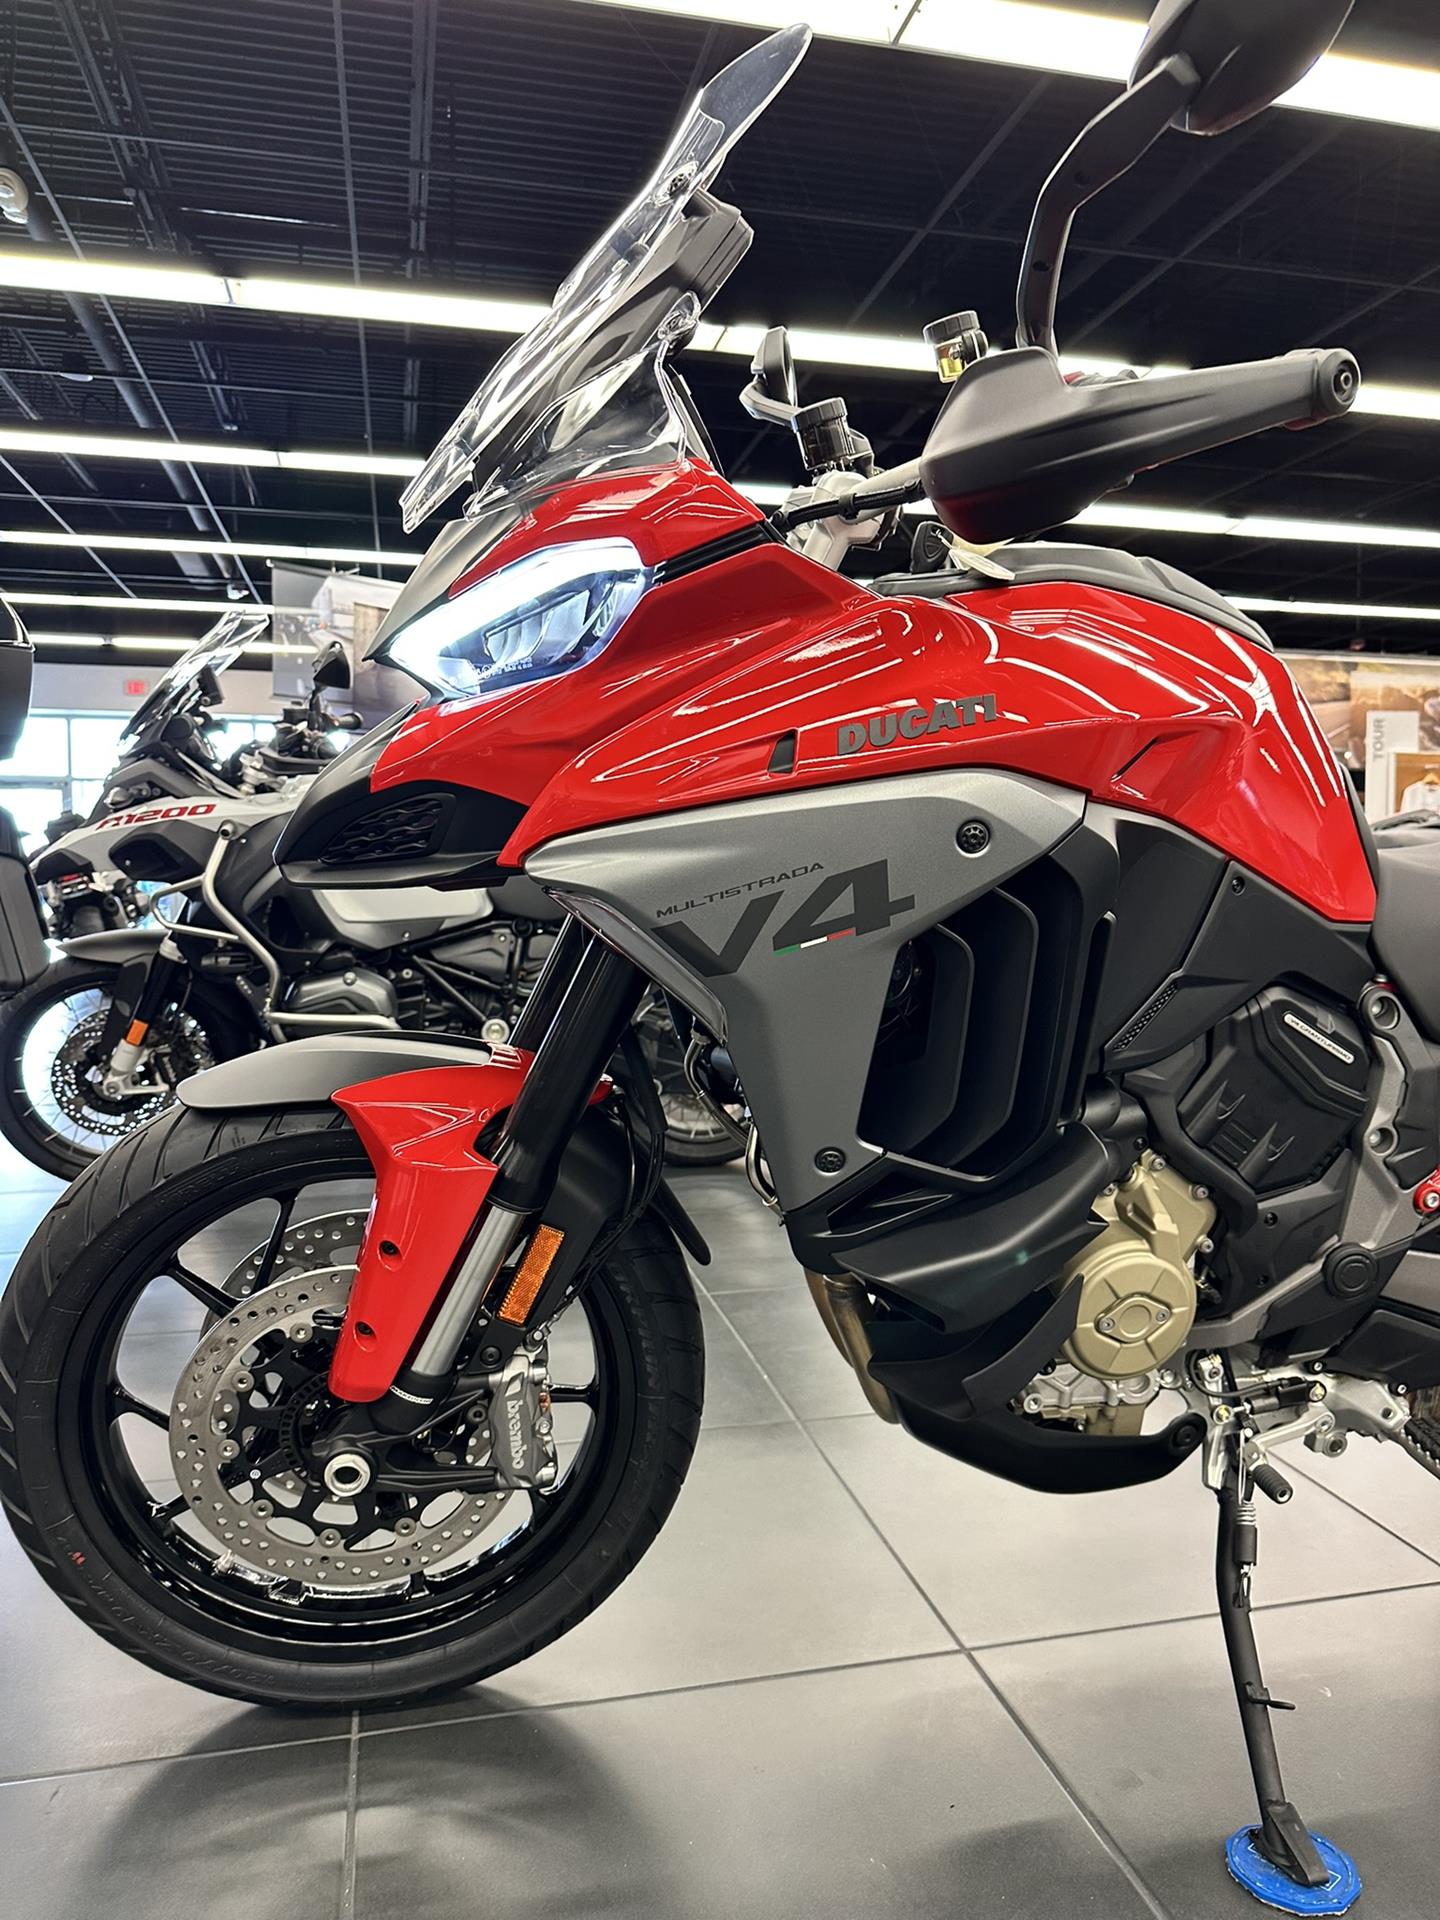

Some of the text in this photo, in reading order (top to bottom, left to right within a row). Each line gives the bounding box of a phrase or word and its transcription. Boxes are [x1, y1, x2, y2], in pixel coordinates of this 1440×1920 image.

[838, 693, 997, 755] DUCATI
[1372, 719, 1386, 762] TOUR
[96, 804, 216, 830] R1200
[651, 859, 915, 977] V4
[656, 862, 824, 918] MULTISTRADA
[507, 1400, 527, 1469] brembo
